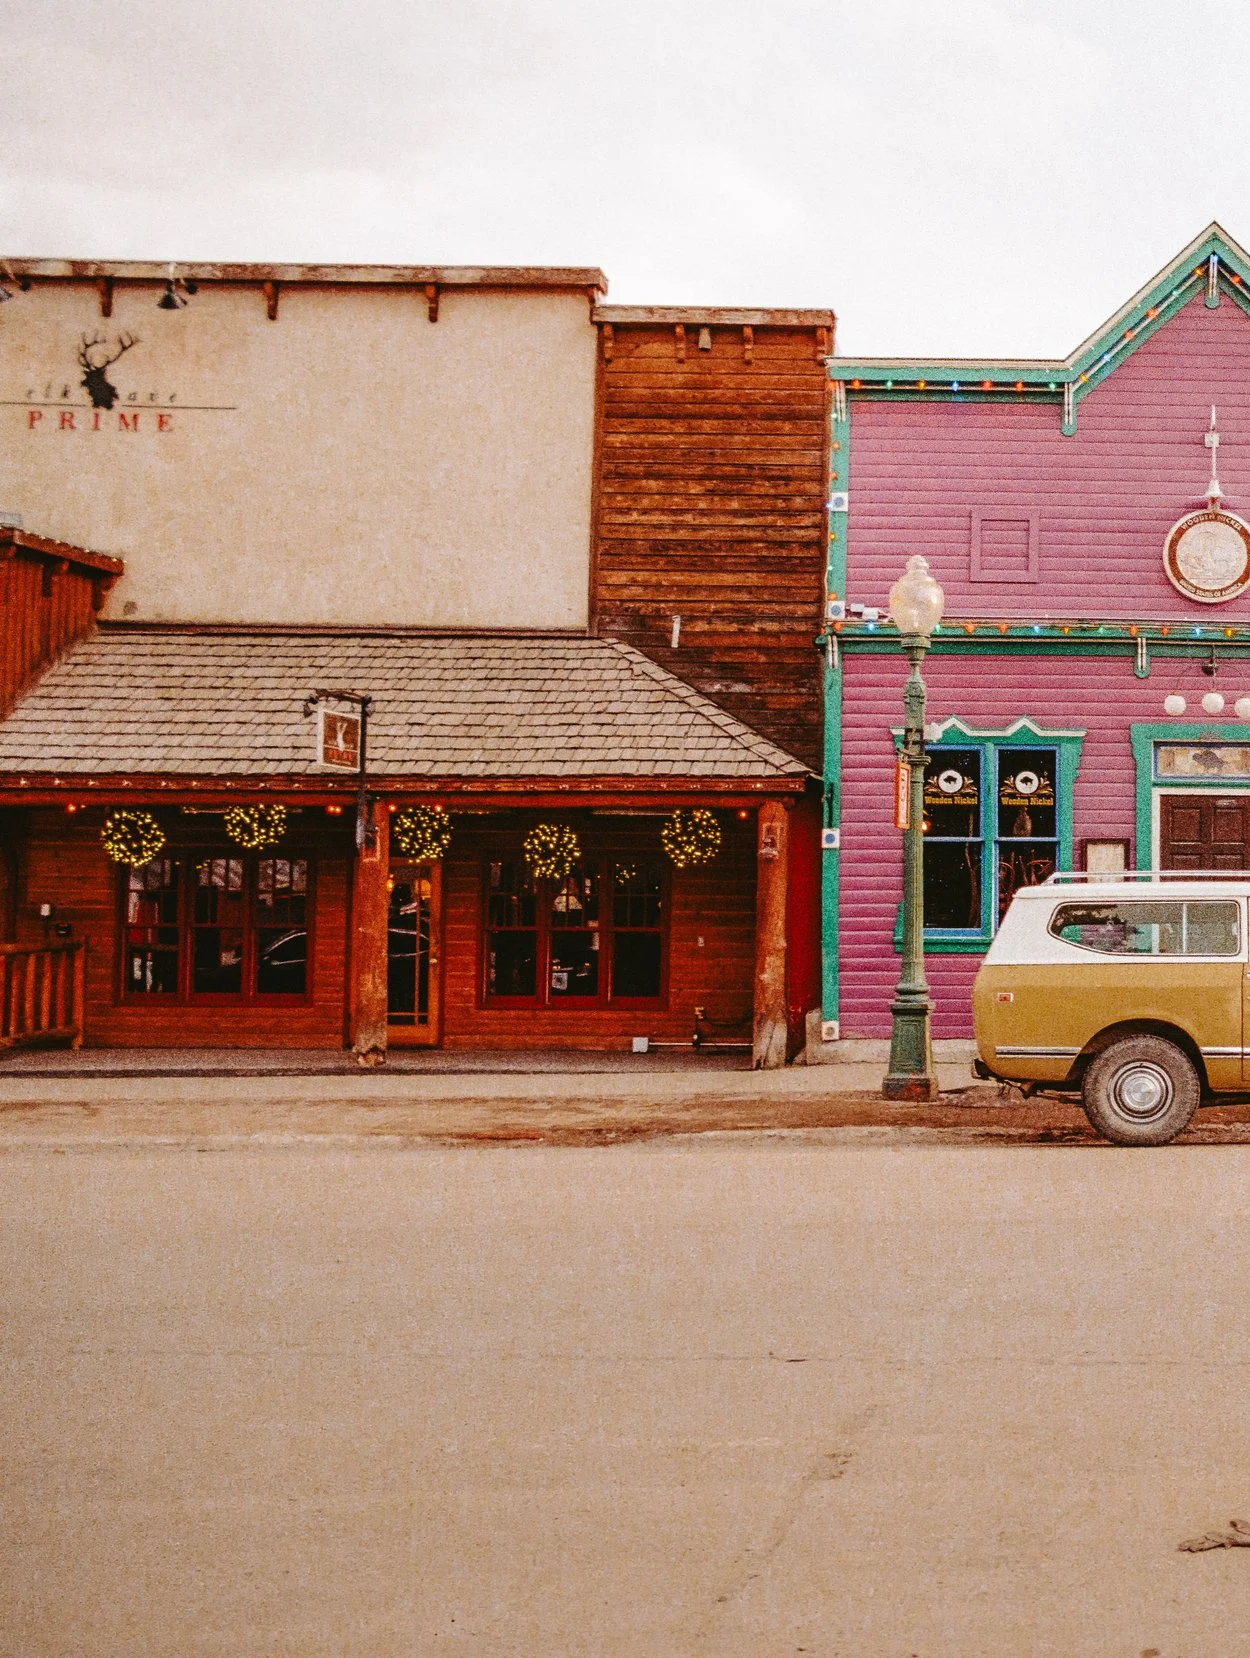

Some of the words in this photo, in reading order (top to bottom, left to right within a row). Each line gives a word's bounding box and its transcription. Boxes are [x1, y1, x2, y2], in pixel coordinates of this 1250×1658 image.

[27, 410, 176, 433] PRIME
[1181, 512, 1215, 530] WOODEN
[1217, 514, 1243, 531] NICKEL
[924, 796, 952, 804] Wooden
[954, 796, 977, 804] Nickel
[1001, 797, 1029, 805] Wooden
[1030, 796, 1054, 806] Nickel
